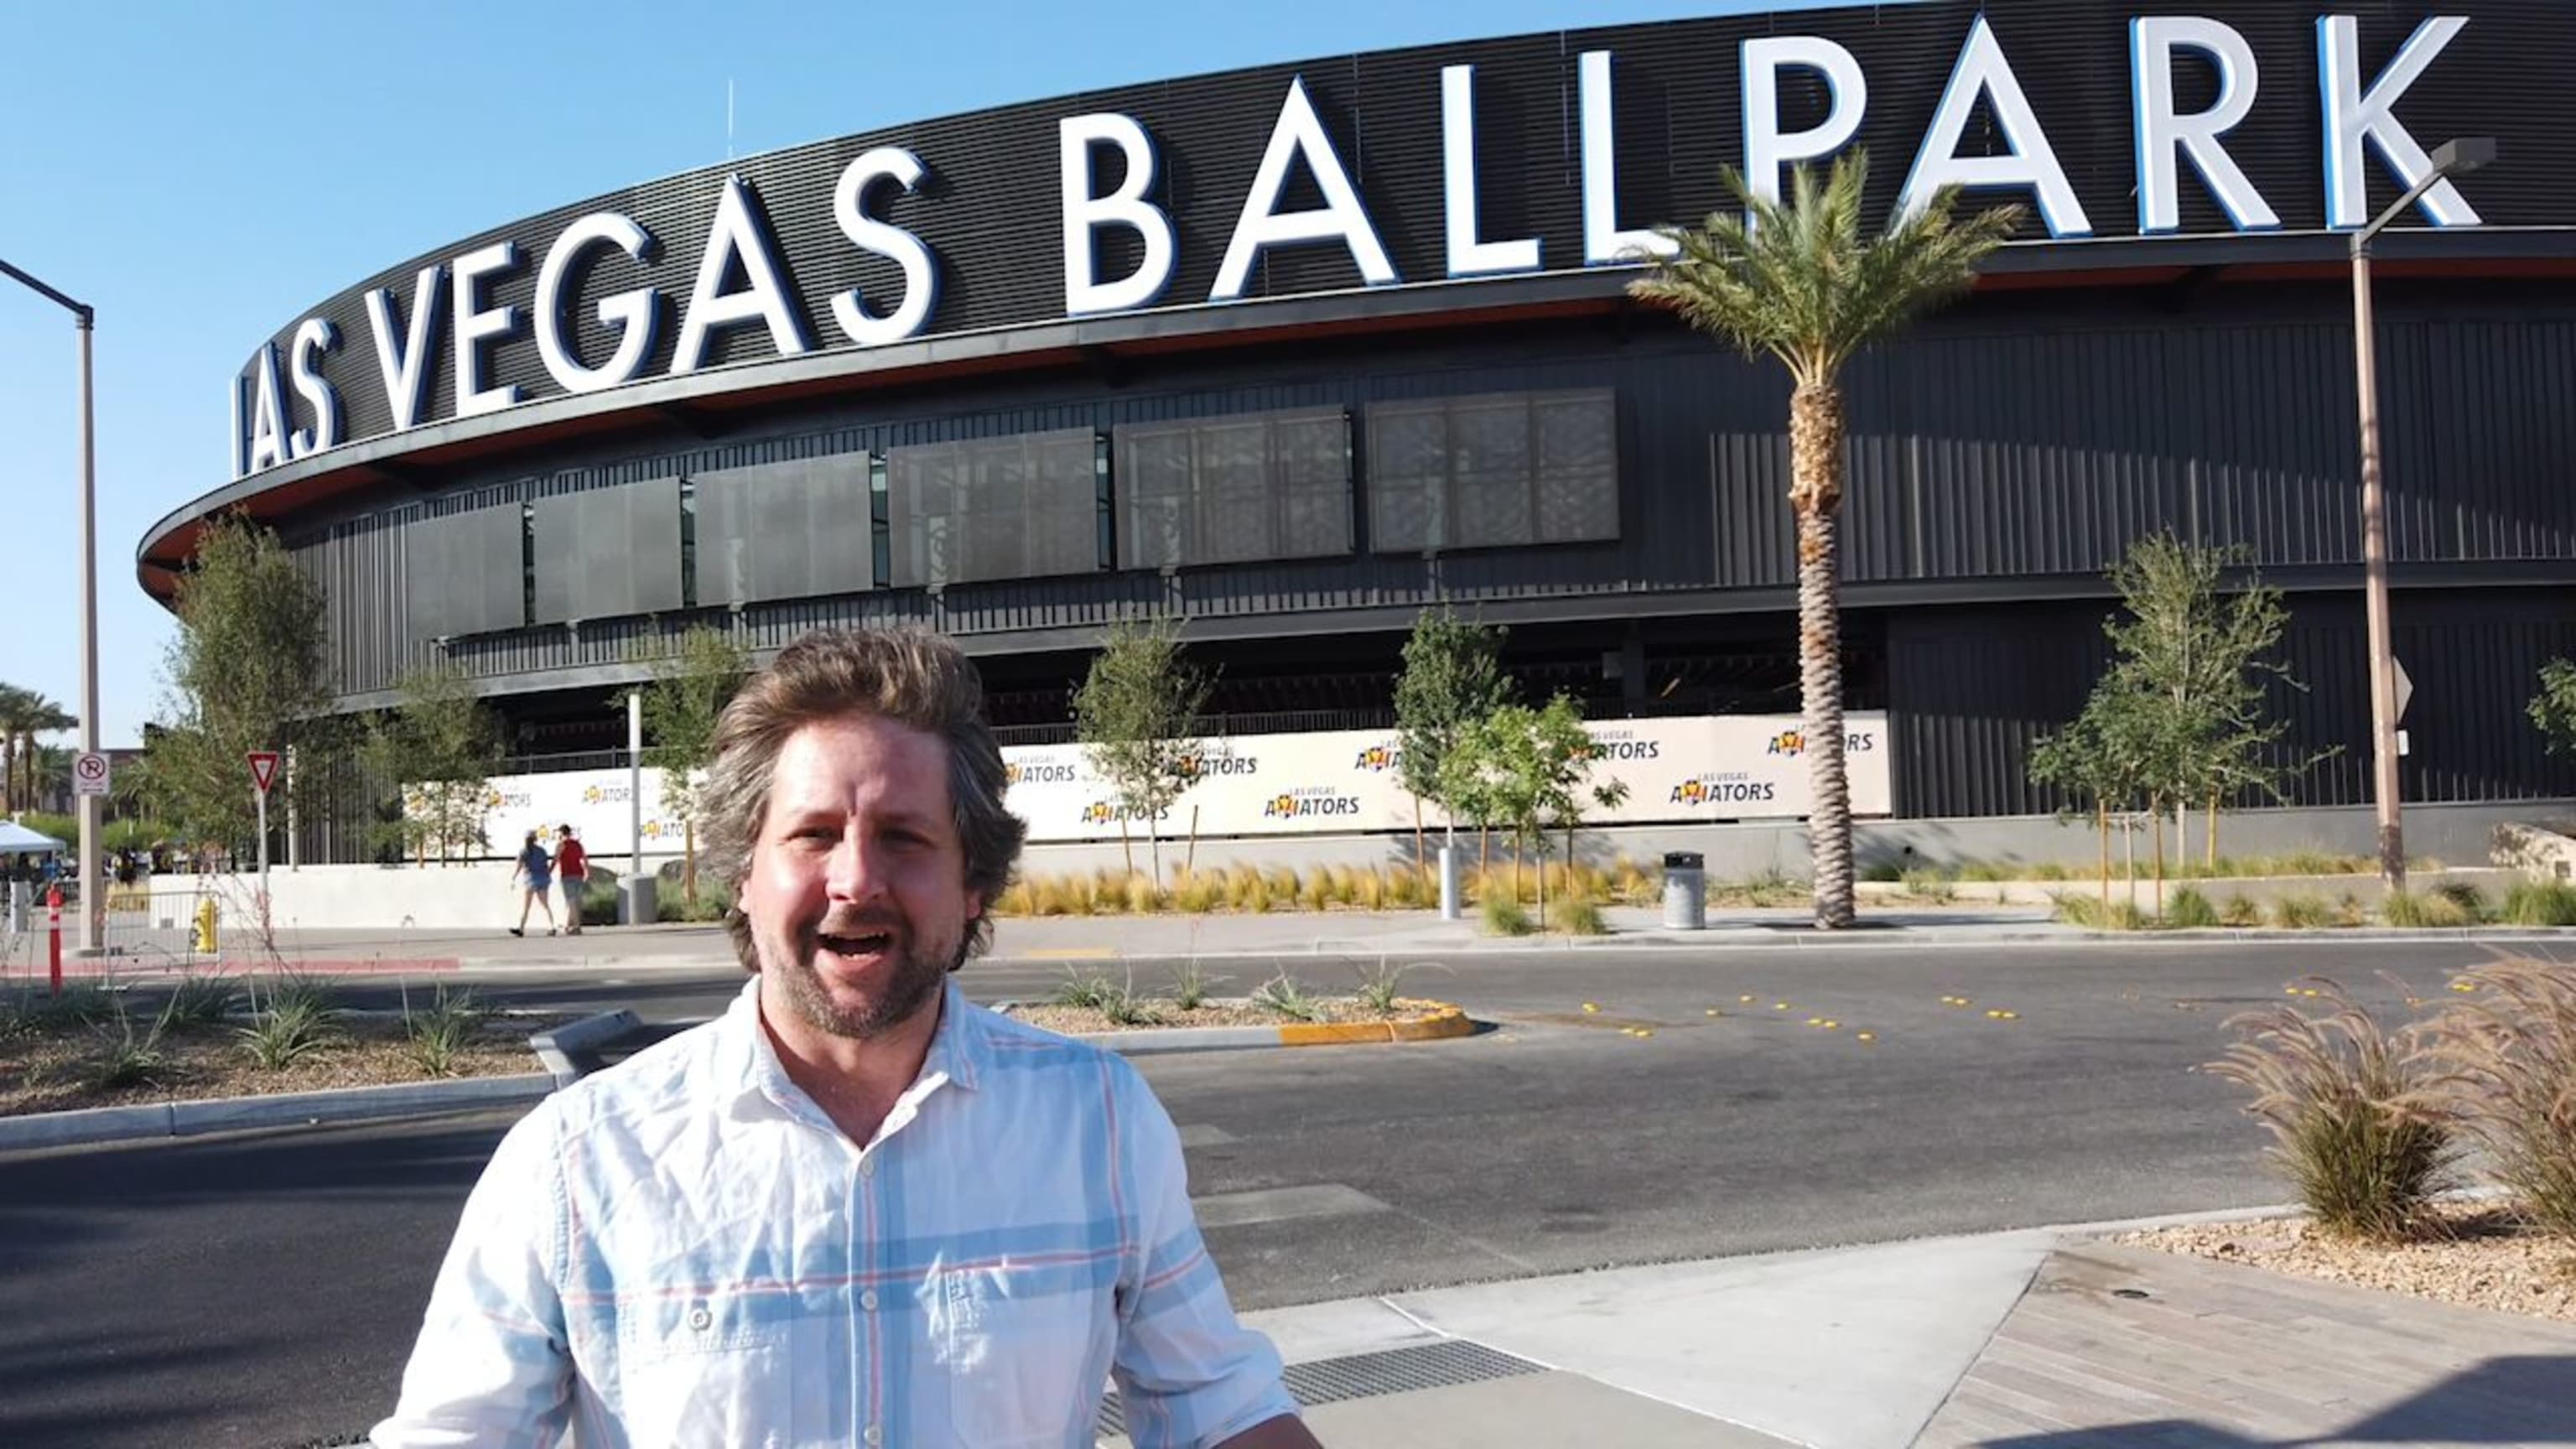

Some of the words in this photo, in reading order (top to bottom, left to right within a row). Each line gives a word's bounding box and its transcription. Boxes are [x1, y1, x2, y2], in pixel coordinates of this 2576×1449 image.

[231, 318, 334, 480] LAS
[364, 145, 940, 433] VEGAS
[1058, 13, 2483, 317] BALLPARK
[1768, 731, 1872, 756] AVIRS
[1005, 763, 1075, 784] VIATORS
[581, 785, 631, 805] AVIATOR
[1670, 781, 1774, 804] AVIATORS
[1265, 796, 1359, 818] AVIATORS
